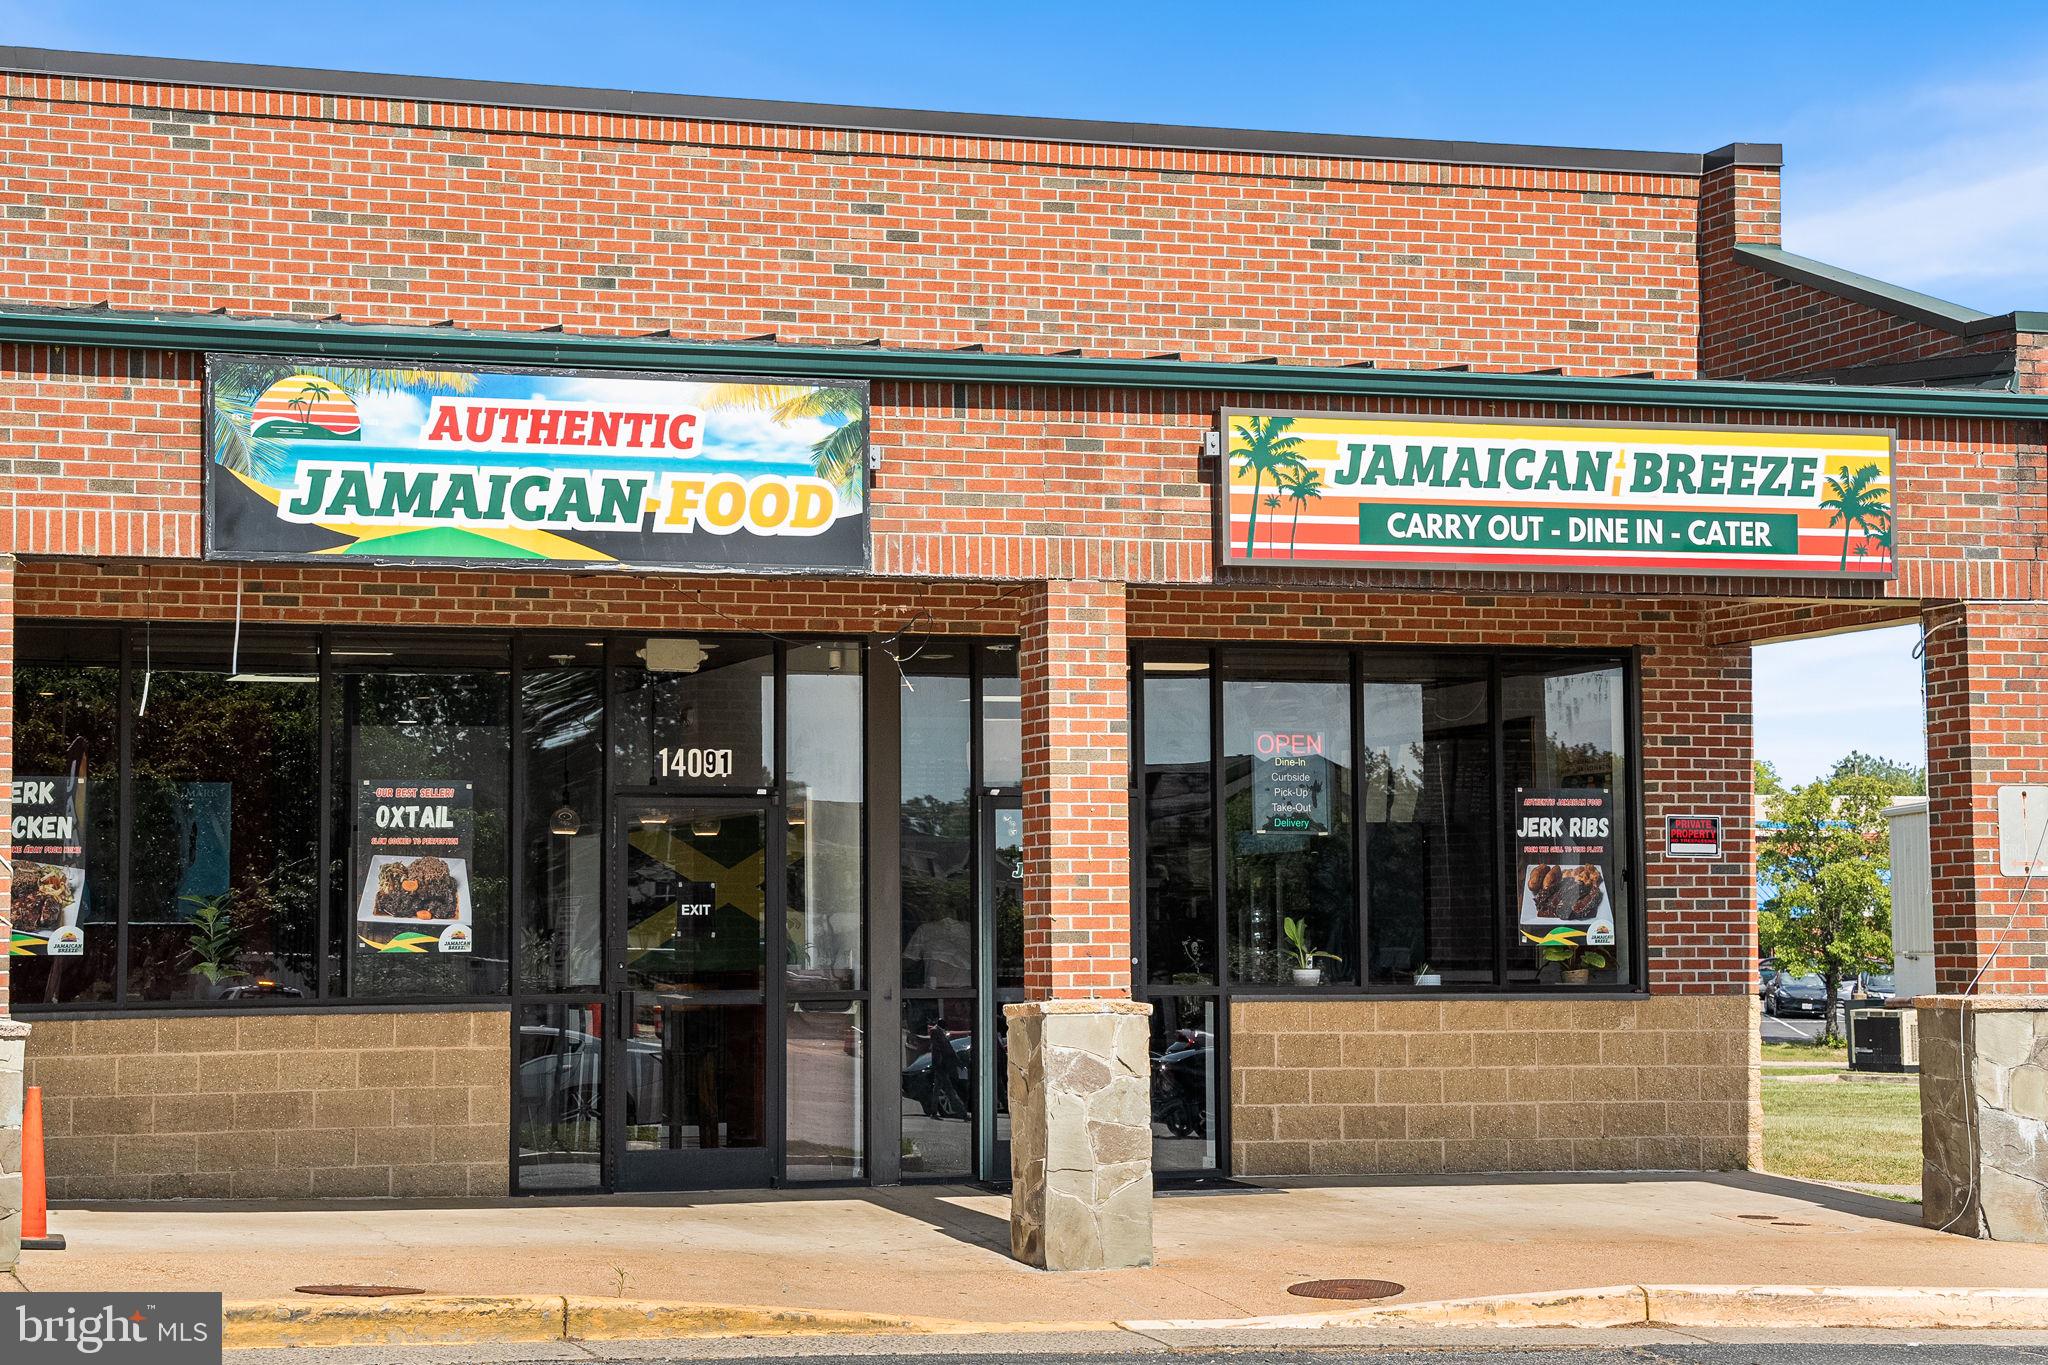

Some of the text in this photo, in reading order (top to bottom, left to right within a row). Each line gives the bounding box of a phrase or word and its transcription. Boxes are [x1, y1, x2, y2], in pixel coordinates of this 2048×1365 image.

[428, 404, 698, 451] AUTHENTIC
[1334, 442, 1819, 498] JAMAICAN BREEZE
[289, 467, 833, 529] JAMAICAN FOOD
[1387, 512, 1481, 541] CARRY
[1494, 515, 1545, 543] OUT
[1569, 516, 1629, 545] DINE
[1636, 518, 1664, 546] IN
[1688, 520, 1772, 548] CATER
[1257, 734, 1324, 754] OPEN
[658, 747, 733, 778] 14091
[1274, 757, 1306, 767] Dine-In
[1271, 772, 1311, 782] Curbside
[12, 781, 55, 804] ERK
[376, 787, 455, 798] OUR BEST SELLER!
[1274, 788, 1309, 798] Pick-Up
[1271, 802, 1312, 812] Take-Out
[1523, 798, 1603, 807] AUTHENTIC JAMAICAN FOOD
[375, 805, 454, 828] OXTAIL
[12, 815, 73, 839] CKEN
[1274, 818, 1310, 829] Delivery
[1516, 816, 1609, 838] JERK RIBS
[1675, 819, 1712, 829] PRIVATE
[1670, 829, 1717, 839] PROPERTY
[371, 837, 459, 845] SLOW COOKED TO PERFECTION
[1524, 845, 1539, 853] FROM
[1539, 845, 1549, 853] THE
[1564, 845, 1572, 853] TO
[1572, 845, 1587, 853] YOUR
[1587, 845, 1604, 853] PLATE
[681, 904, 711, 916] EXIT
